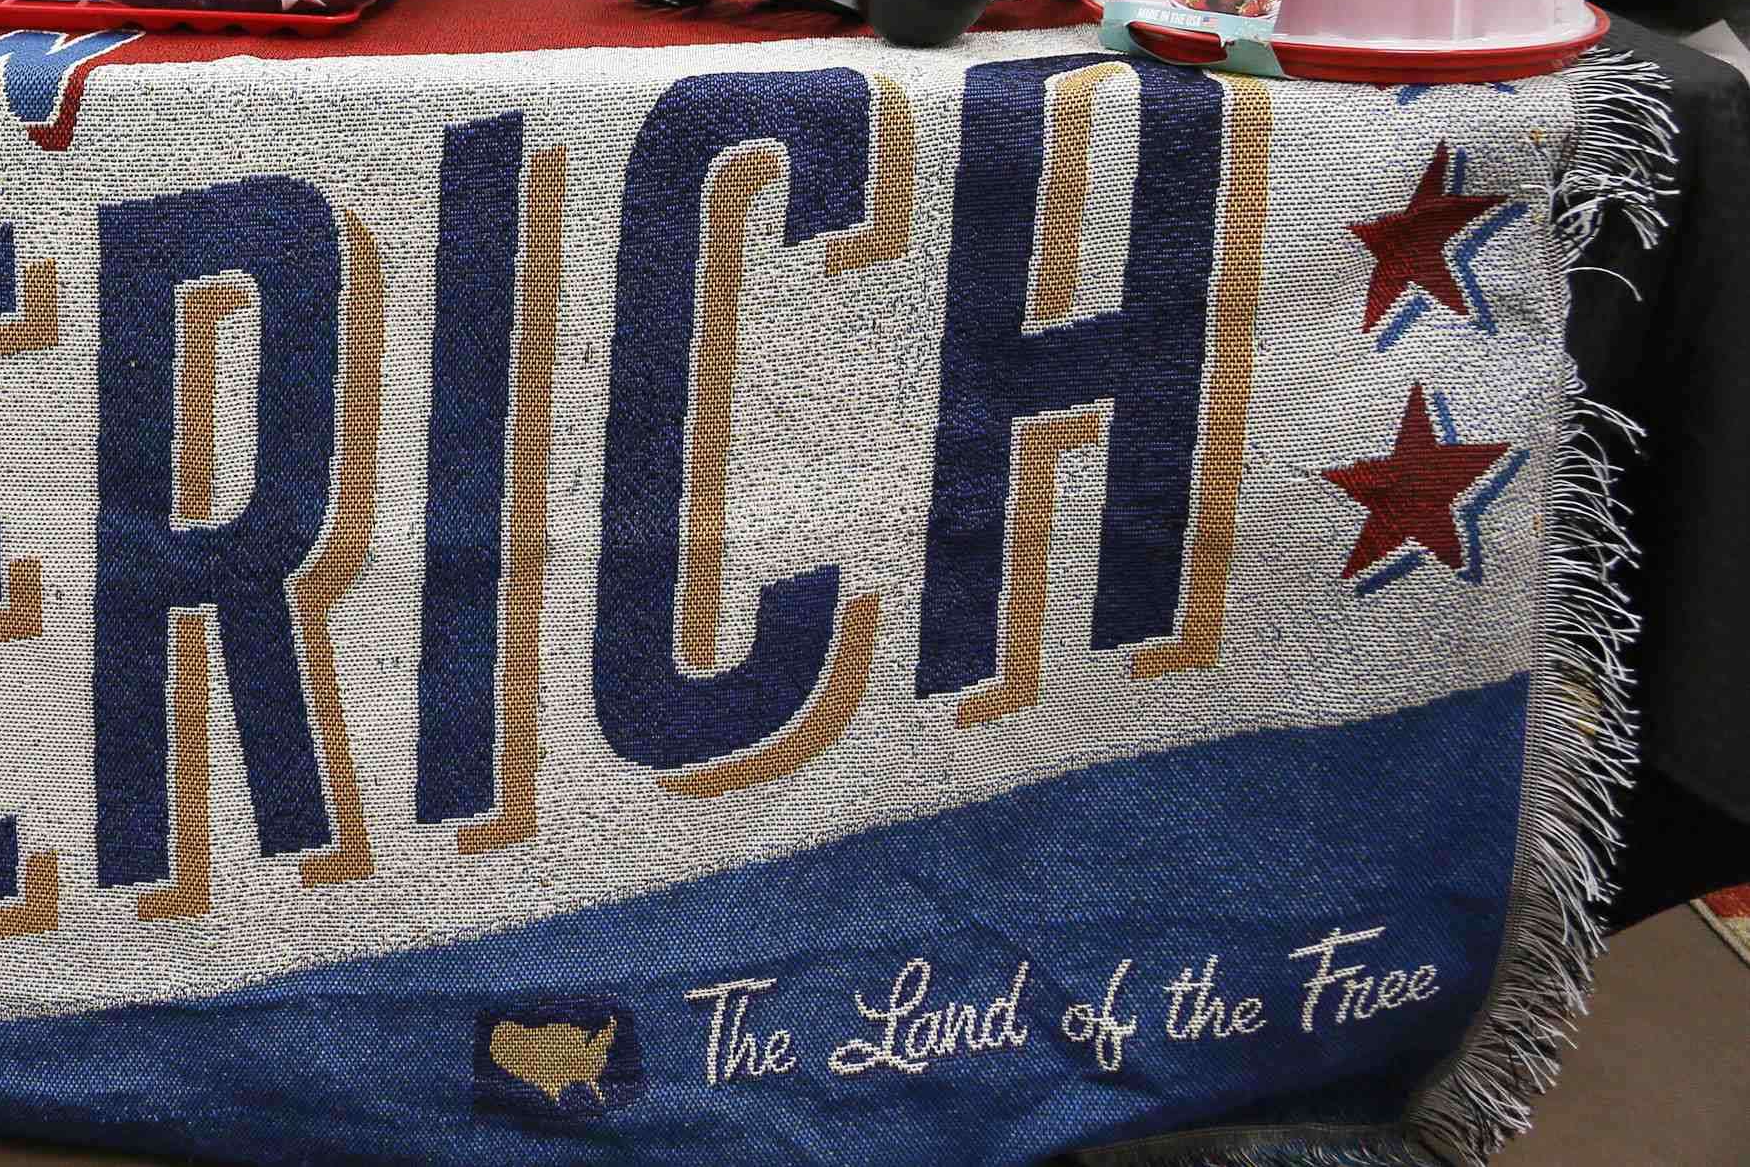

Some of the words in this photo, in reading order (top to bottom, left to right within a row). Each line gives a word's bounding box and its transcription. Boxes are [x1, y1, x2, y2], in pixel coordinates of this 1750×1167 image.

[685, 979, 795, 1084] The
[830, 958, 1027, 1076] Land
[1062, 959, 1135, 1070] of
[1163, 954, 1266, 1041] the
[1289, 927, 1440, 1032] Free
